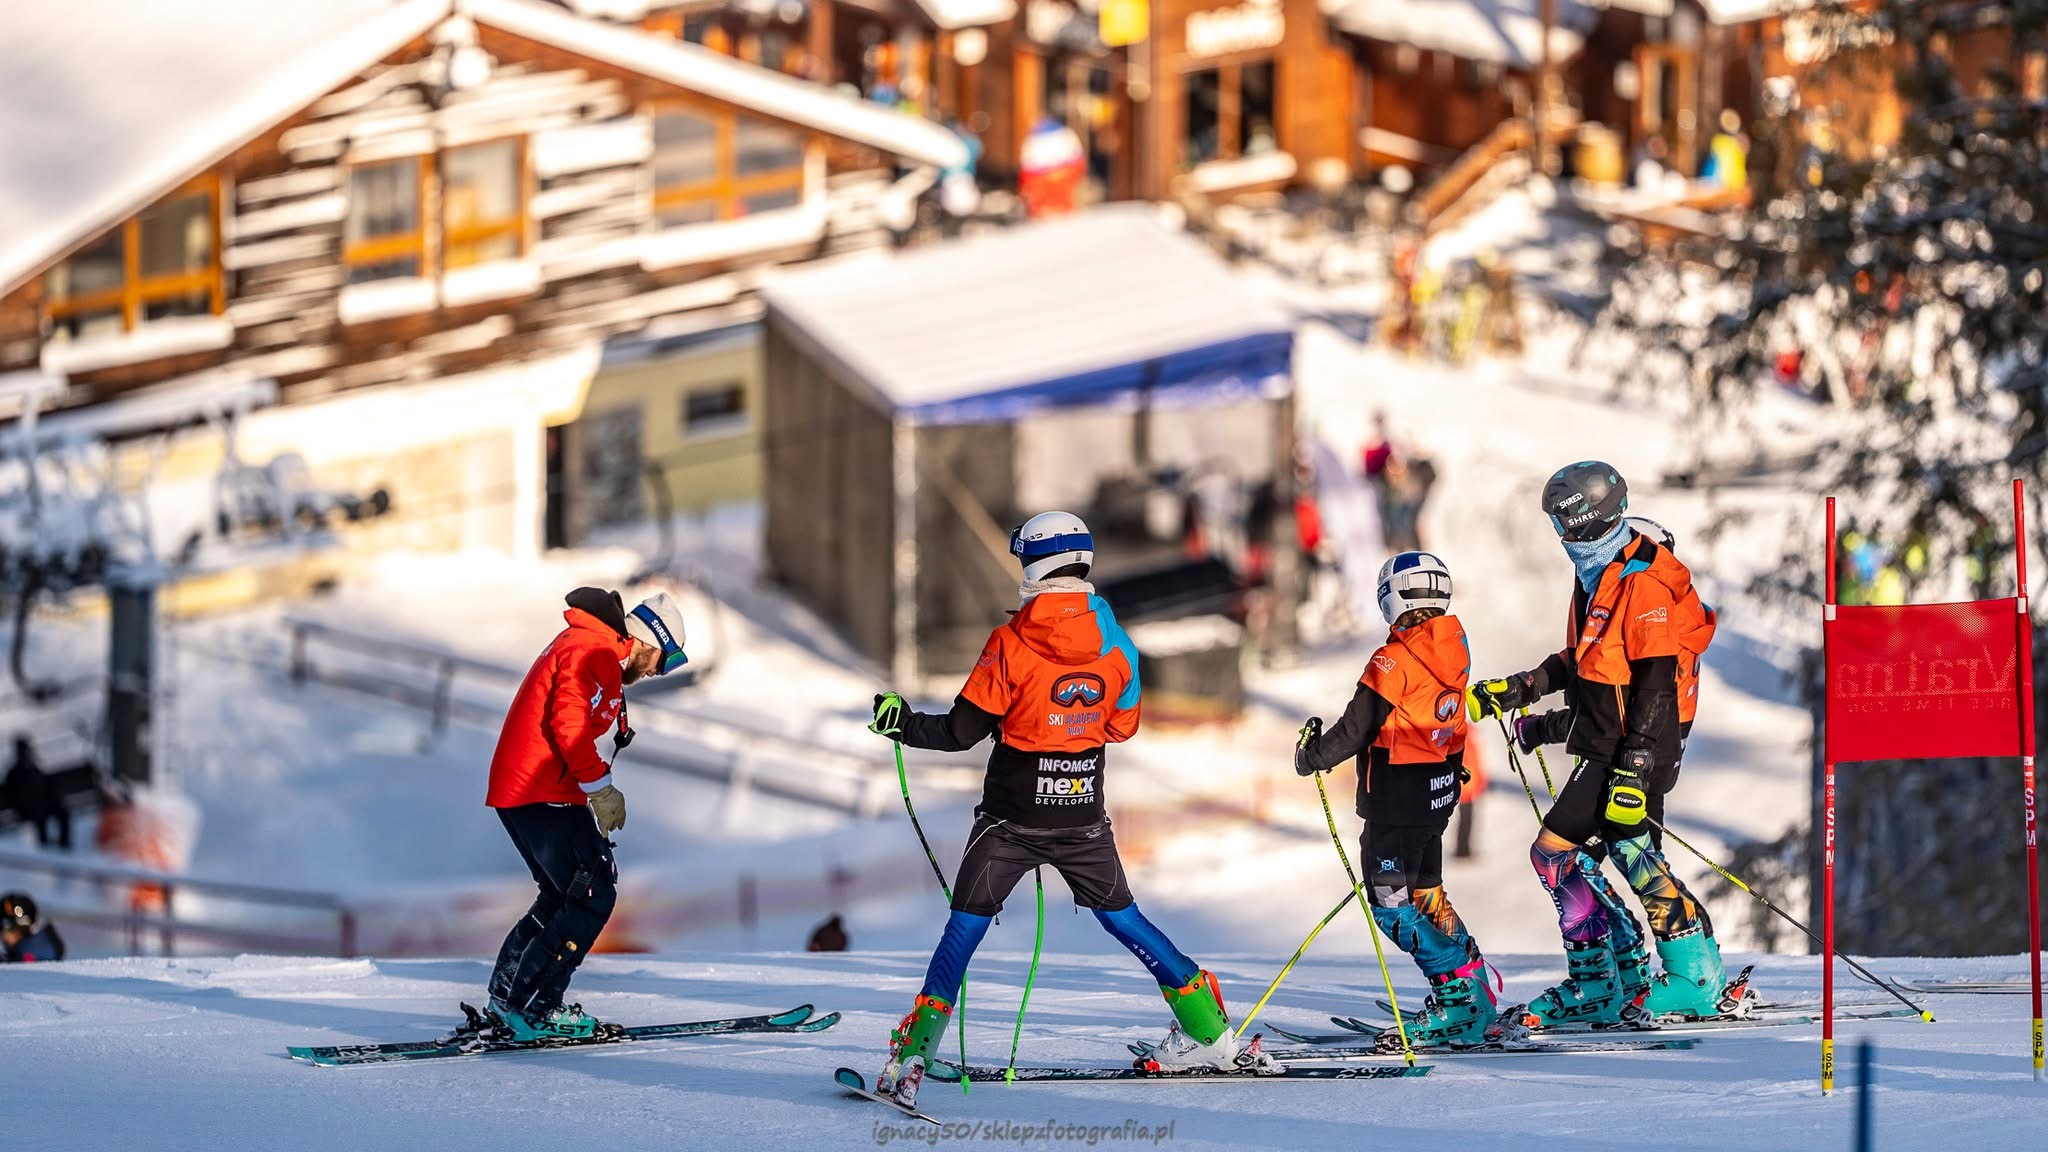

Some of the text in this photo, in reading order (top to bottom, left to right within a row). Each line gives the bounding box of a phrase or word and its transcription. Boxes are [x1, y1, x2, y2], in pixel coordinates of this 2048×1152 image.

[1048, 713, 1064, 726] SKI
[1038, 757, 1096, 773] INFOMEX
[1036, 776, 1096, 795] nexx
[1035, 796, 1095, 806] DEVELOPER
[2024, 787, 2036, 847] SPM
[2034, 1031, 2044, 1059] SPM
[1823, 1052, 1833, 1080] SPM
